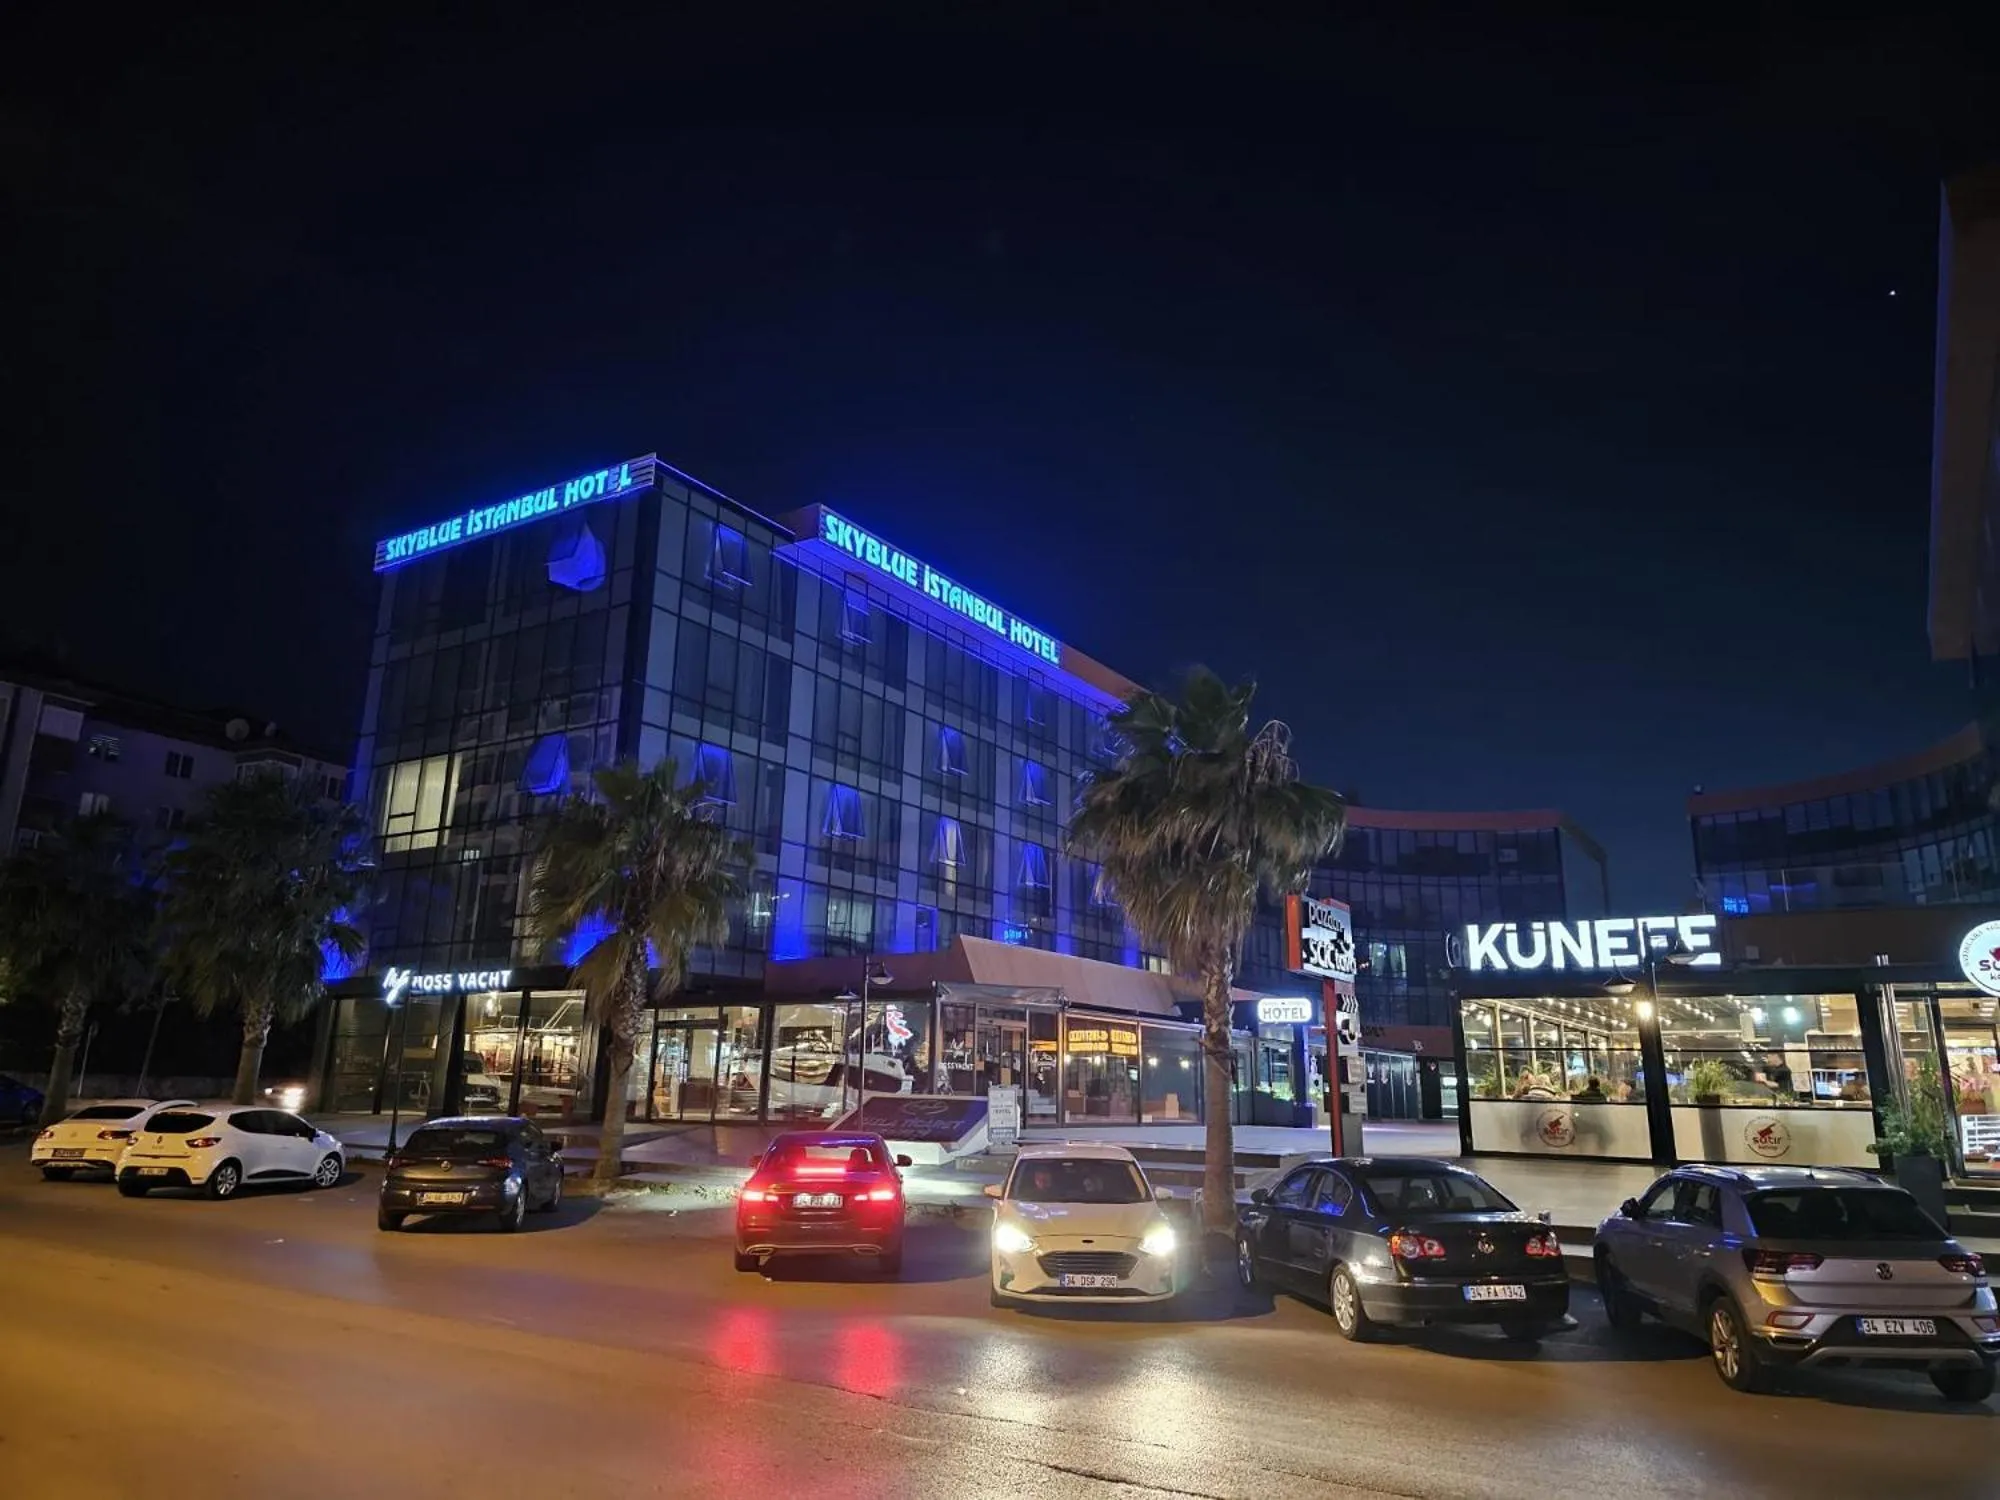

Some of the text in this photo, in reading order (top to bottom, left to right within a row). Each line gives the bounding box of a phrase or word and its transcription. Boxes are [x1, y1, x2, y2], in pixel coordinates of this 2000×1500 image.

[385, 463, 632, 560] SKYBLUE İSTANBUL HOTEL
[825, 514, 1059, 664] SKYBLUE İSTANBUL HOTEL
[1466, 914, 1721, 970] KÜNEFE
[411, 973, 452, 990] MOSS
[458, 970, 512, 990] YACHT
[1262, 1007, 1307, 1020] HOTEL
[1066, 1275, 1076, 1286] 34
[1471, 1286, 1525, 1299] 34 FA 1342
[1863, 1319, 1878, 1333] 34
[1912, 1320, 1934, 1334] 406
